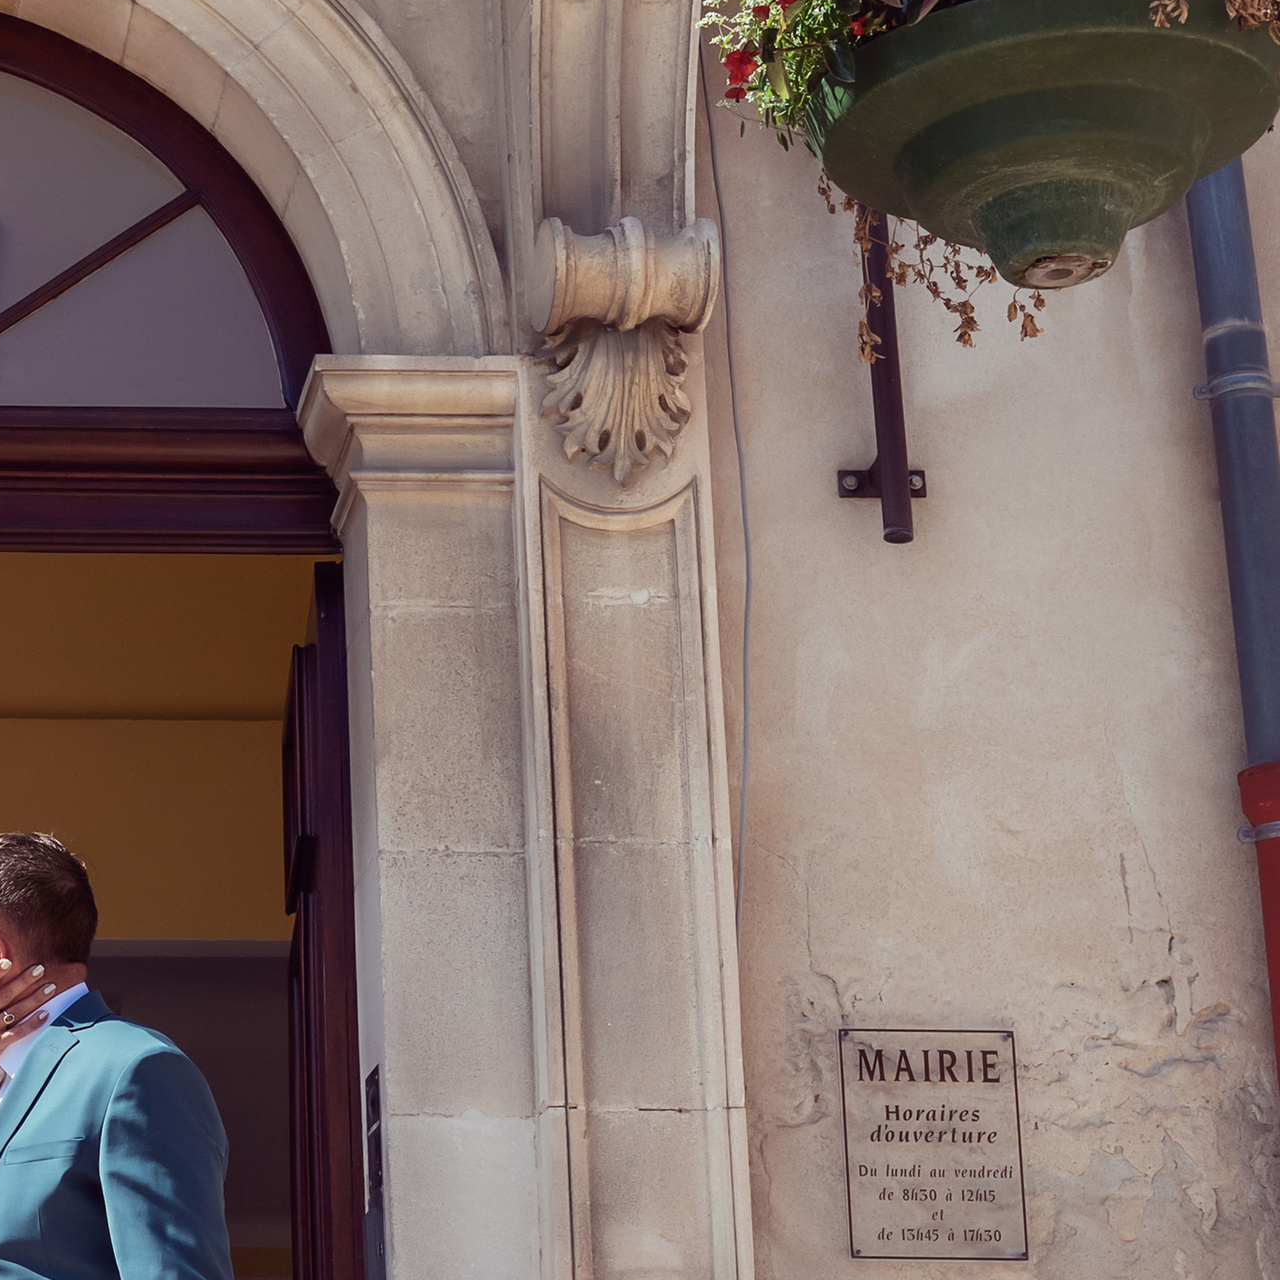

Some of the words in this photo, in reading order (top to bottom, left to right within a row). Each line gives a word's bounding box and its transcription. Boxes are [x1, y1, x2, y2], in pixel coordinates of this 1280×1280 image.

[857, 1048, 1001, 1084] MAIRIE
[884, 1104, 981, 1122] Horaires
[870, 1124, 998, 1144] d'ouverture
[858, 1164, 877, 1177] Du
[886, 1164, 921, 1178] lundi
[929, 1167, 946, 1178] au
[954, 1165, 1013, 1179] vendredi
[878, 1188, 894, 1201] de
[902, 1188, 937, 1202] 8h30
[945, 1188, 953, 1202] à
[961, 1189, 996, 1202] 12h15
[931, 1209, 944, 1221] et
[877, 1228, 893, 1241] de
[901, 1228, 939, 1242] 13h45
[947, 1228, 955, 1242] à
[963, 1228, 1002, 1242] 17h30
